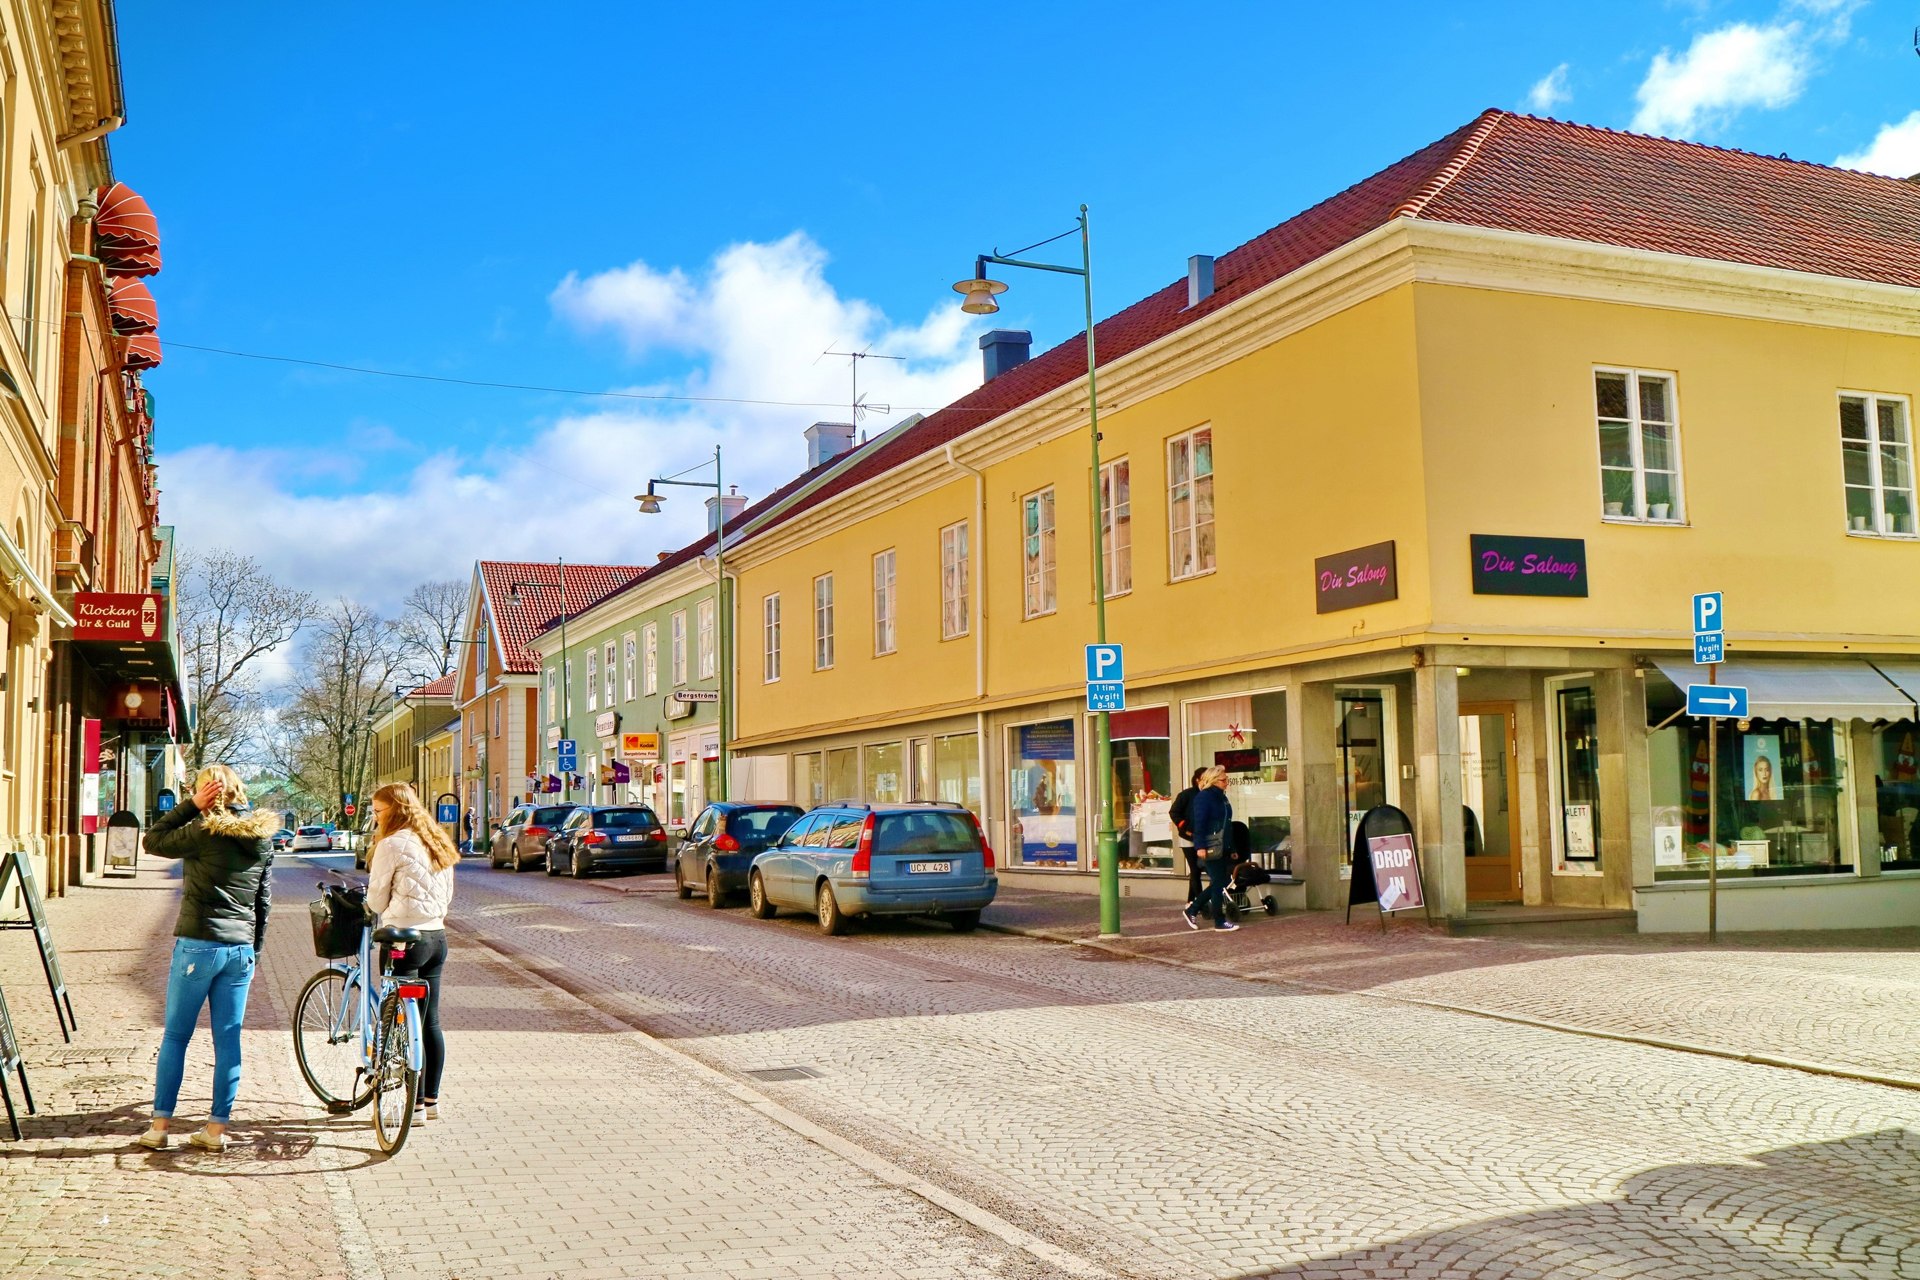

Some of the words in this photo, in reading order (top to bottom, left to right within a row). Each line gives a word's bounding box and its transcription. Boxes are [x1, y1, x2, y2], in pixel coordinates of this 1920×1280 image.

[1482, 550, 1515, 572] Din
[1521, 554, 1579, 580] Salong
[1320, 570, 1342, 592] Din
[1346, 563, 1387, 587] Salong
[80, 603, 139, 616] Klockan
[1700, 597, 1717, 629] P
[79, 619, 91, 628] Ur
[94, 619, 103, 628] &
[106, 619, 130, 628] Guld
[1705, 635, 1716, 643] tim
[1699, 644, 1719, 653] Avgift
[1096, 648, 1116, 677] P
[1093, 693, 1119, 701] Avgift
[563, 741, 572, 754] P
[1565, 808, 1586, 816] ALETT
[1374, 848, 1412, 869] DROP
[911, 863, 927, 872] UCX
[933, 863, 949, 872] 428
[1390, 876, 1406, 894] IN
